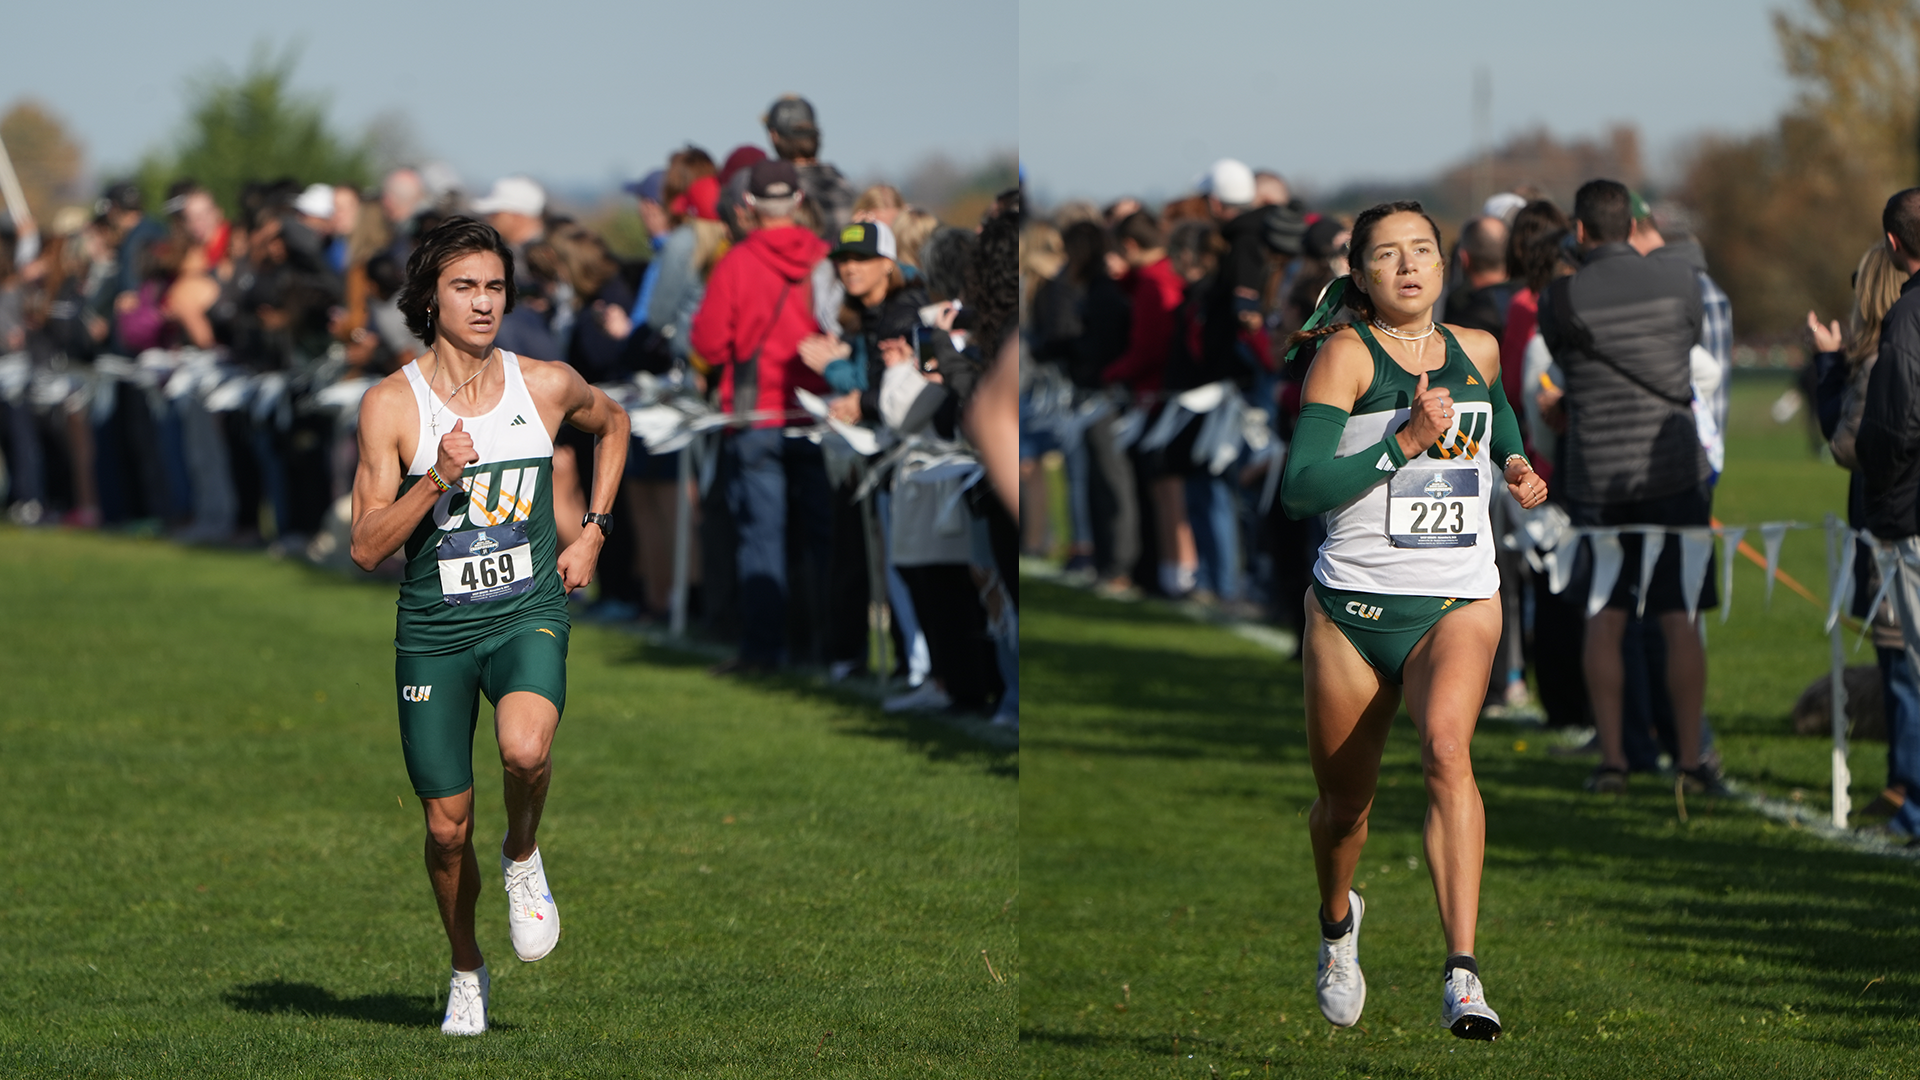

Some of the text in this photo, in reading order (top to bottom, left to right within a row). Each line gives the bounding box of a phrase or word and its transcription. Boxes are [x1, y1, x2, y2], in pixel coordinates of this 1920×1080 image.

[432, 466, 539, 531] CUI
[1410, 501, 1464, 534] 223
[460, 553, 515, 591] 469
[1345, 600, 1383, 621] CUI
[402, 685, 432, 703] CUI
